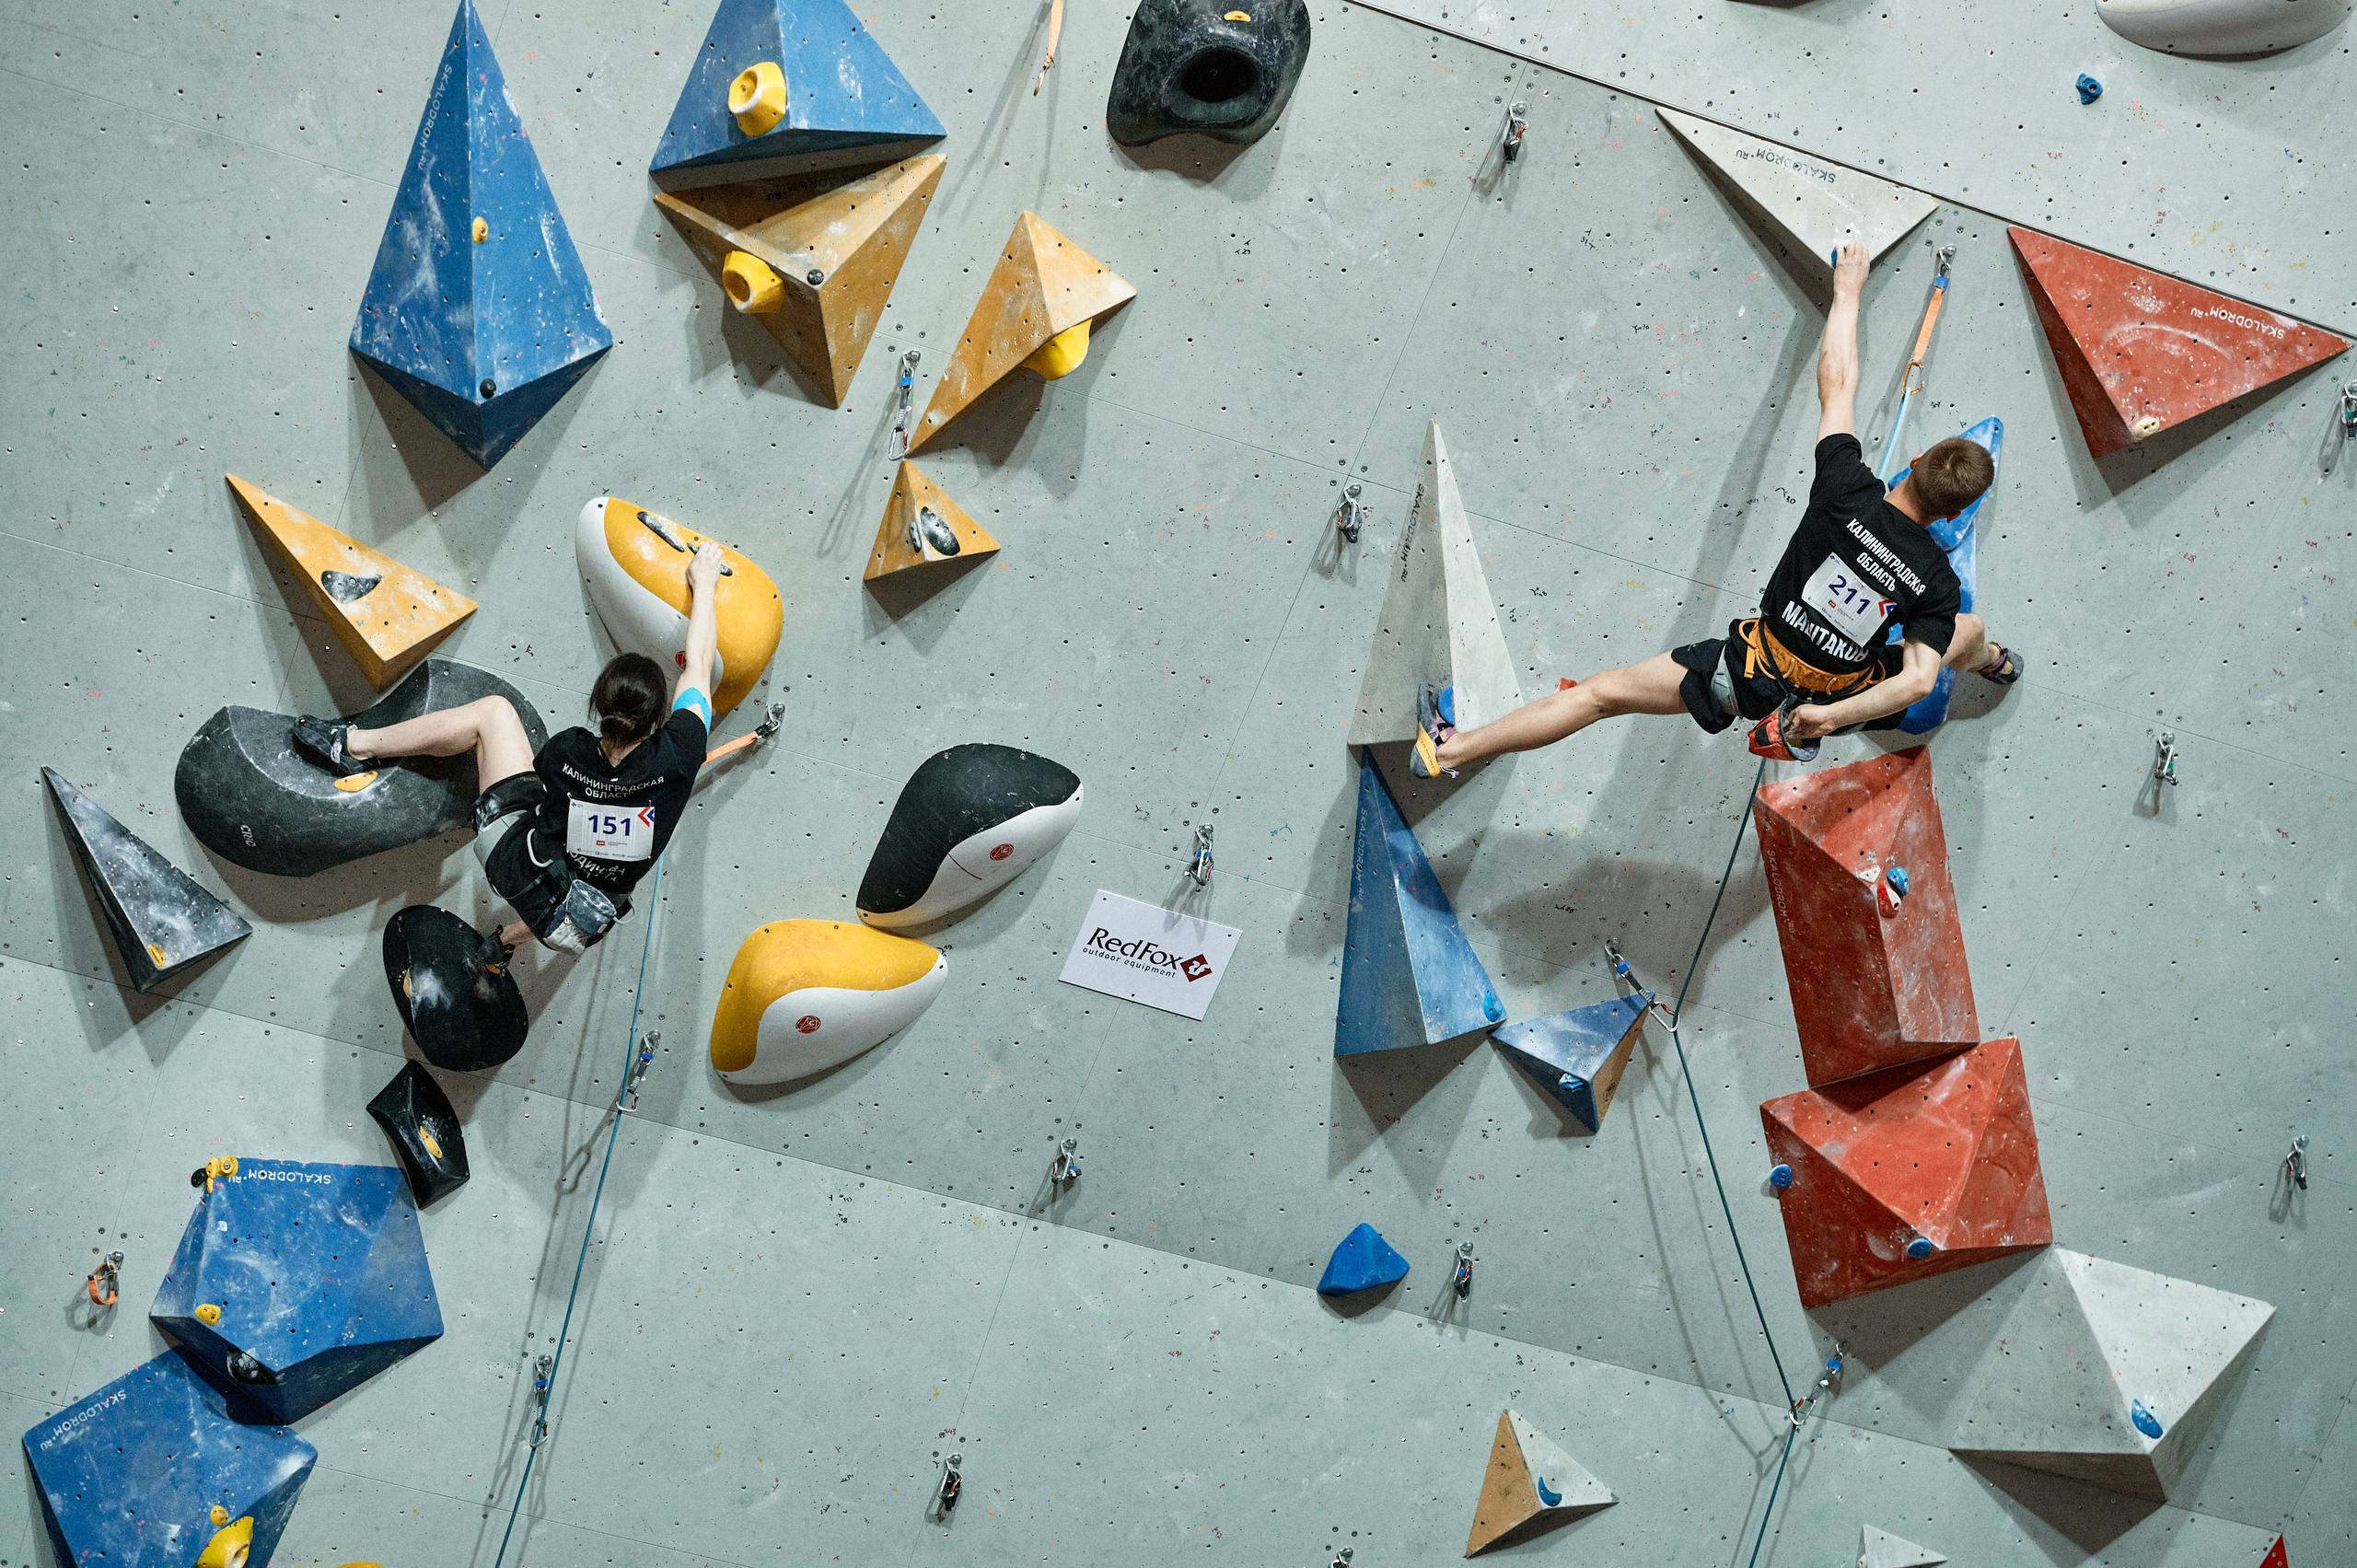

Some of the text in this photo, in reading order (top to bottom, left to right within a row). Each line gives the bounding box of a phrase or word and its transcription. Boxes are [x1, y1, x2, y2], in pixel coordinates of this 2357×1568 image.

[1846, 517, 1926, 596] КАЛИНИНГРАДСКАЯ
[1856, 552, 1897, 592] ОБЛАСТЬ
[1829, 575, 1871, 615] 211
[562, 763, 665, 793] КАЛИНИНГРАДСКАЯ
[587, 814, 632, 837] 151
[1083, 947, 1177, 979] outdoor equipment
[1086, 927, 1184, 970] RedFox
